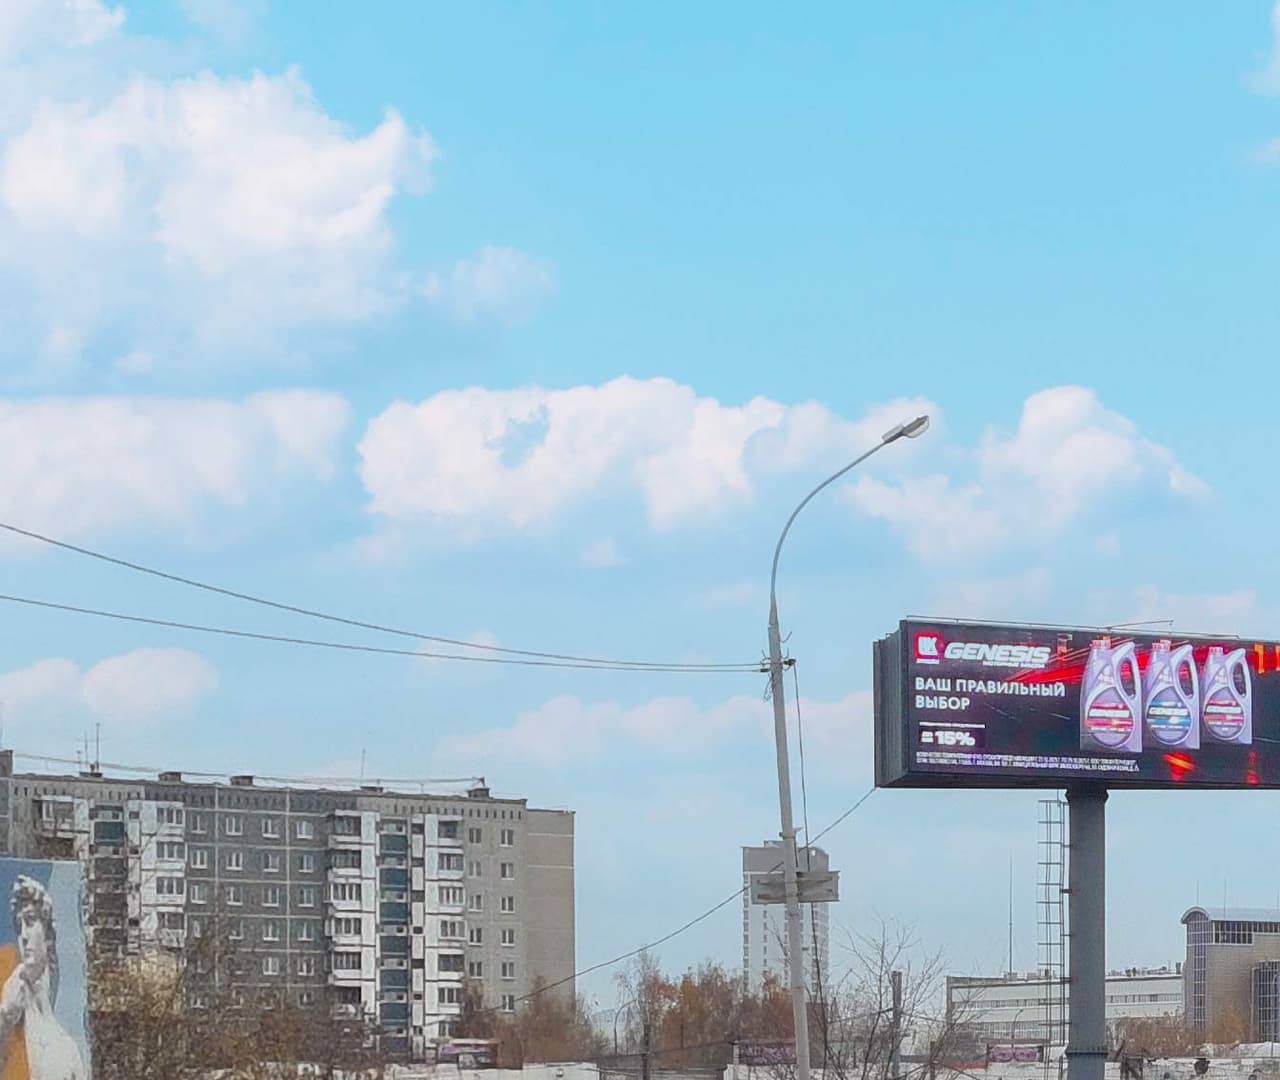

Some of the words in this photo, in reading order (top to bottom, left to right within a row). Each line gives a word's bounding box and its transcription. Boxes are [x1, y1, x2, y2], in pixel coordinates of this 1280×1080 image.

[944, 642, 1051, 664] GENESIS
[915, 677, 951, 692] ВАШ
[956, 679, 1066, 697] ПРАВИЛЬНЫЙ
[915, 695, 970, 710] ВЫБОР
[935, 730, 976, 746] 15%
